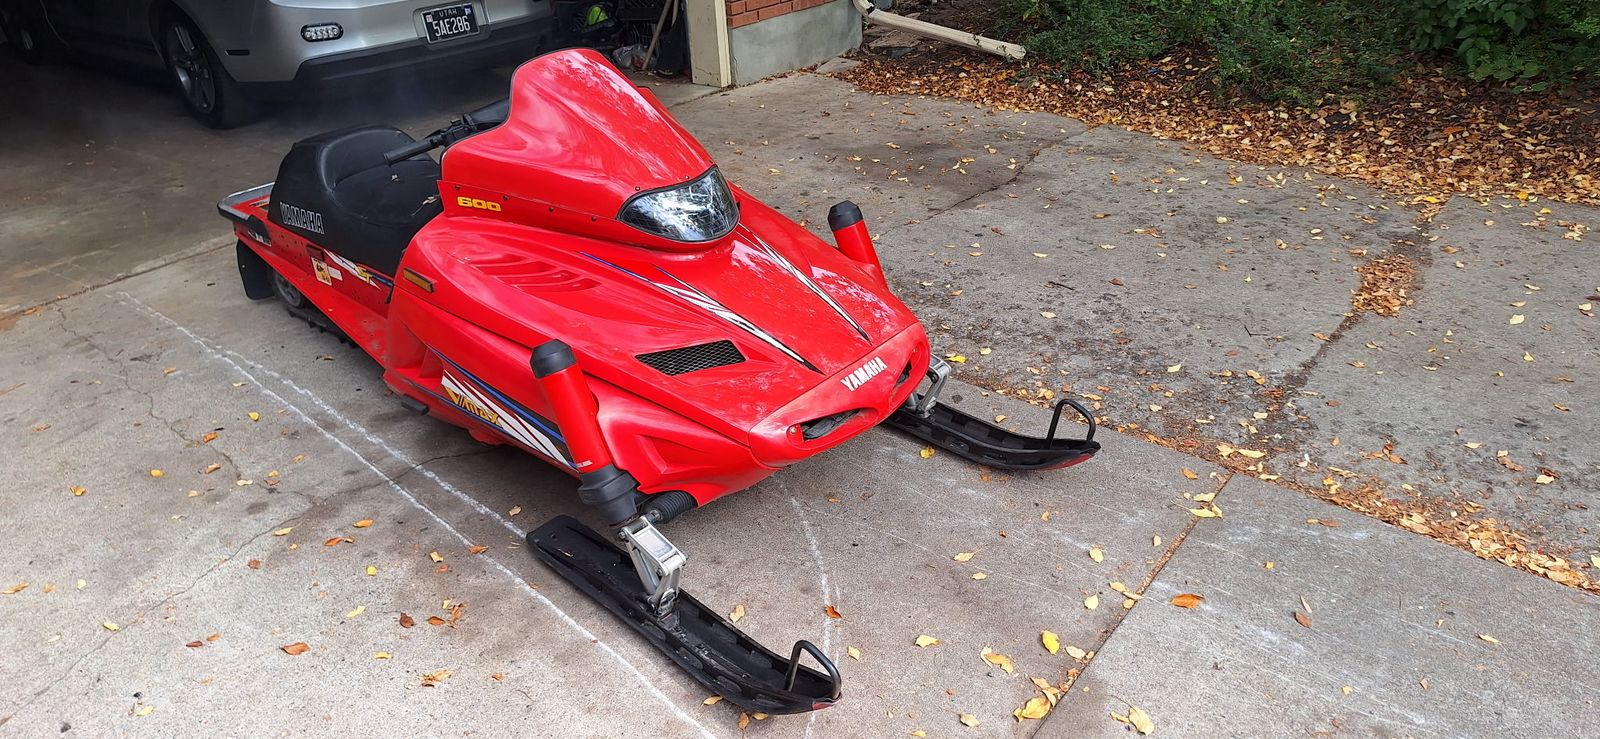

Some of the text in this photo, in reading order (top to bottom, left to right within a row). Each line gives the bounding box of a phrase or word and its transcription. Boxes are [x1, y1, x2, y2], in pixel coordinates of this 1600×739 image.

[439, 8, 457, 17] UTAH
[457, 196, 502, 212] 600
[279, 201, 325, 235] YAMAHA
[840, 356, 888, 392] YAMAHA
